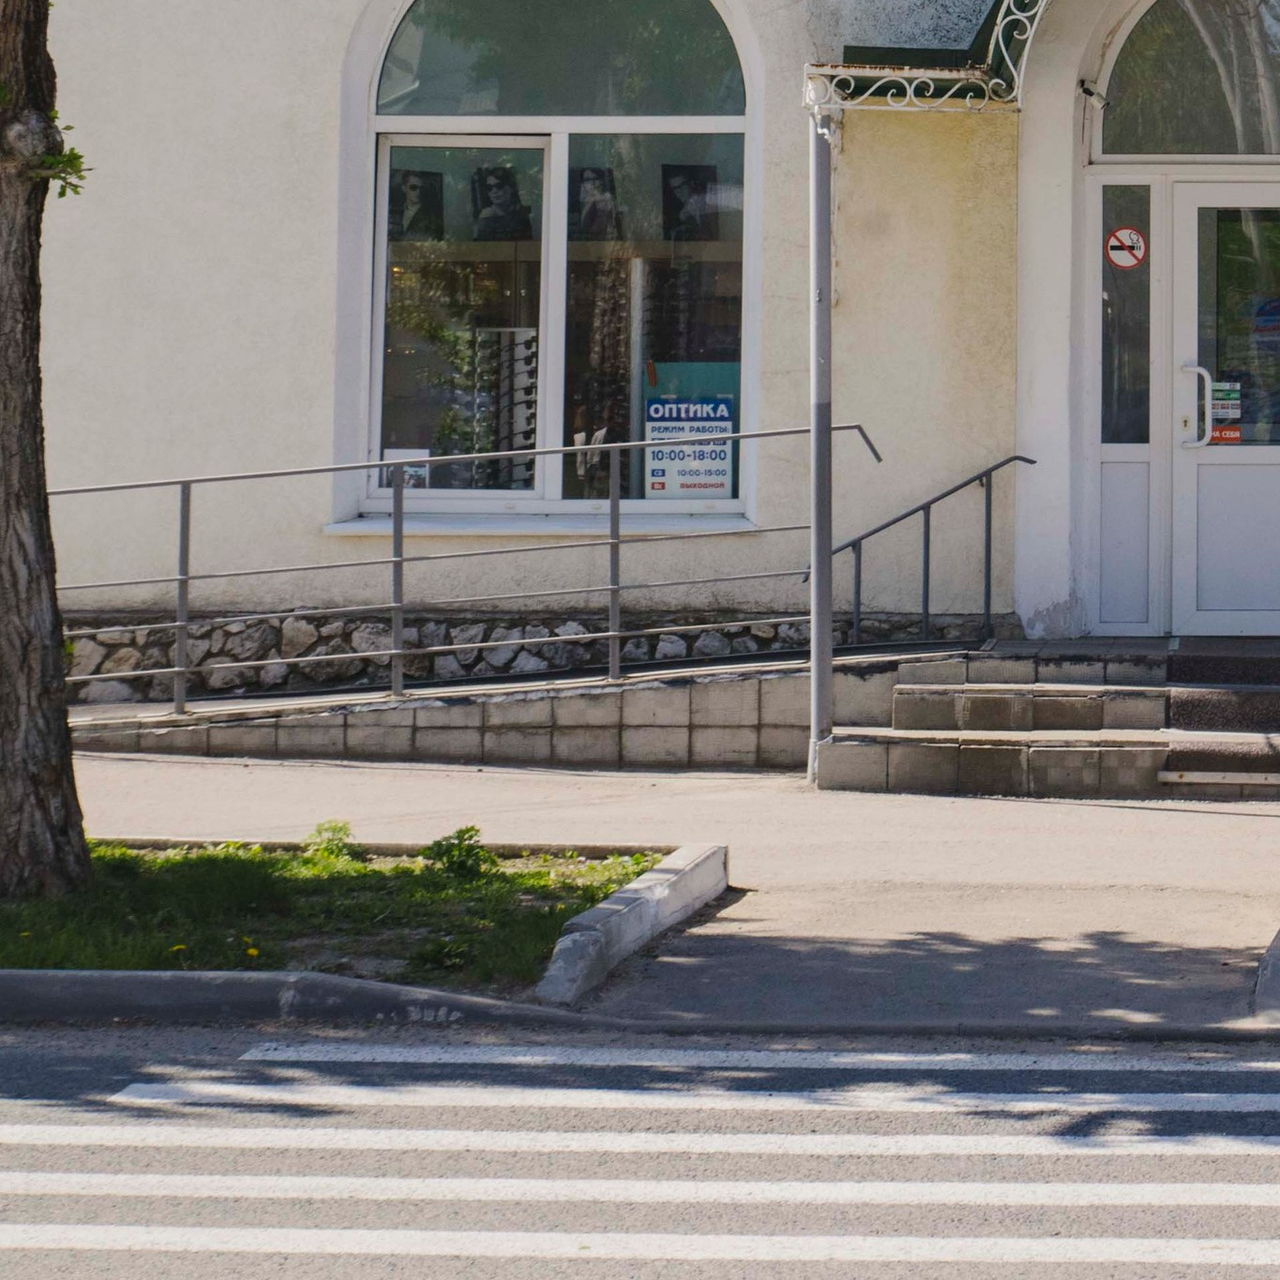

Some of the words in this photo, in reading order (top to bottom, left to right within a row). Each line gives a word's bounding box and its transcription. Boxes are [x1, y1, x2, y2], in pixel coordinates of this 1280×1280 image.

[649, 403, 730, 419] ОПТИКА
[651, 426, 685, 434] РЕЖИМ
[651, 449, 727, 461] 10:00-18:00
[677, 469, 727, 477] 10:00-15:00
